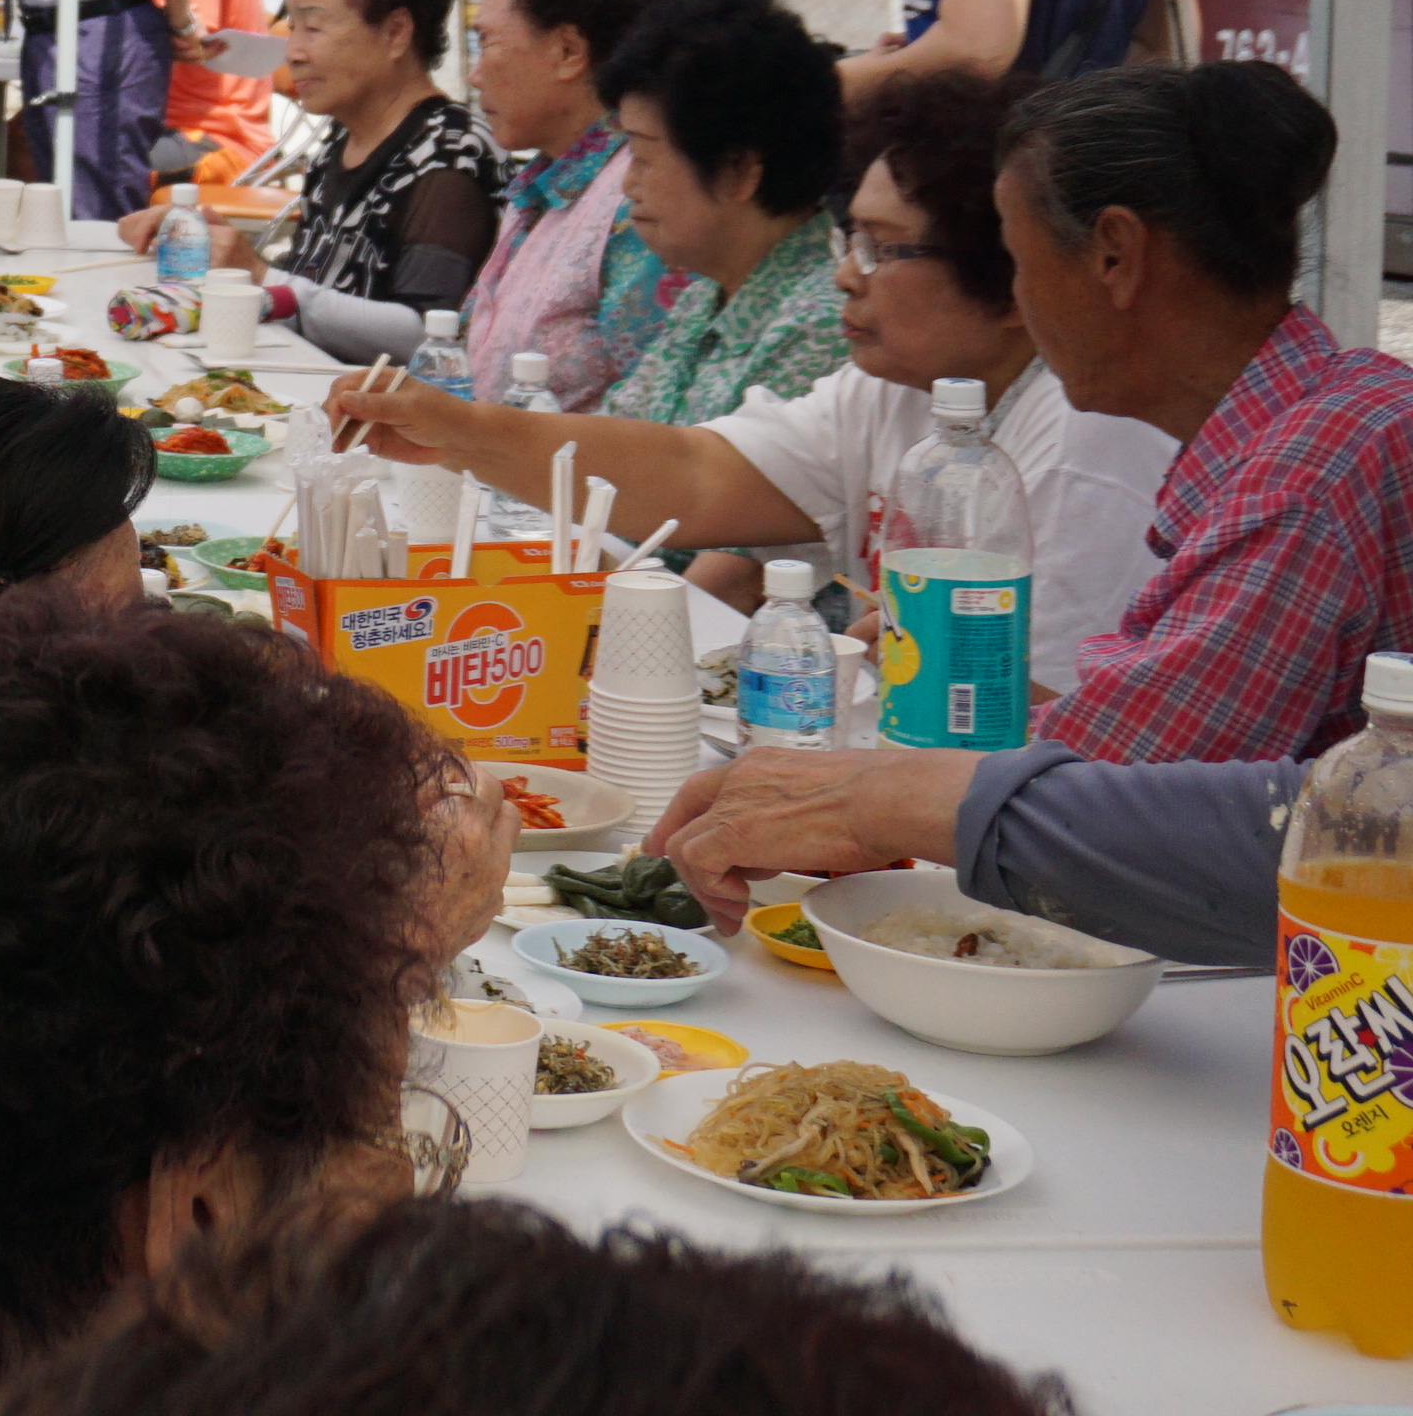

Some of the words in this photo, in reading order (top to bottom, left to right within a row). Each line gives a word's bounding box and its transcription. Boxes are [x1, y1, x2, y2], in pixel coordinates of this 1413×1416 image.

[341, 606, 403, 631] 대한민국
[351, 619, 433, 651] 청춘하세요!
[426, 639, 544, 707] 비타500
[494, 736, 530, 749] 500mg
[1341, 1102, 1390, 1138] 오렌지
